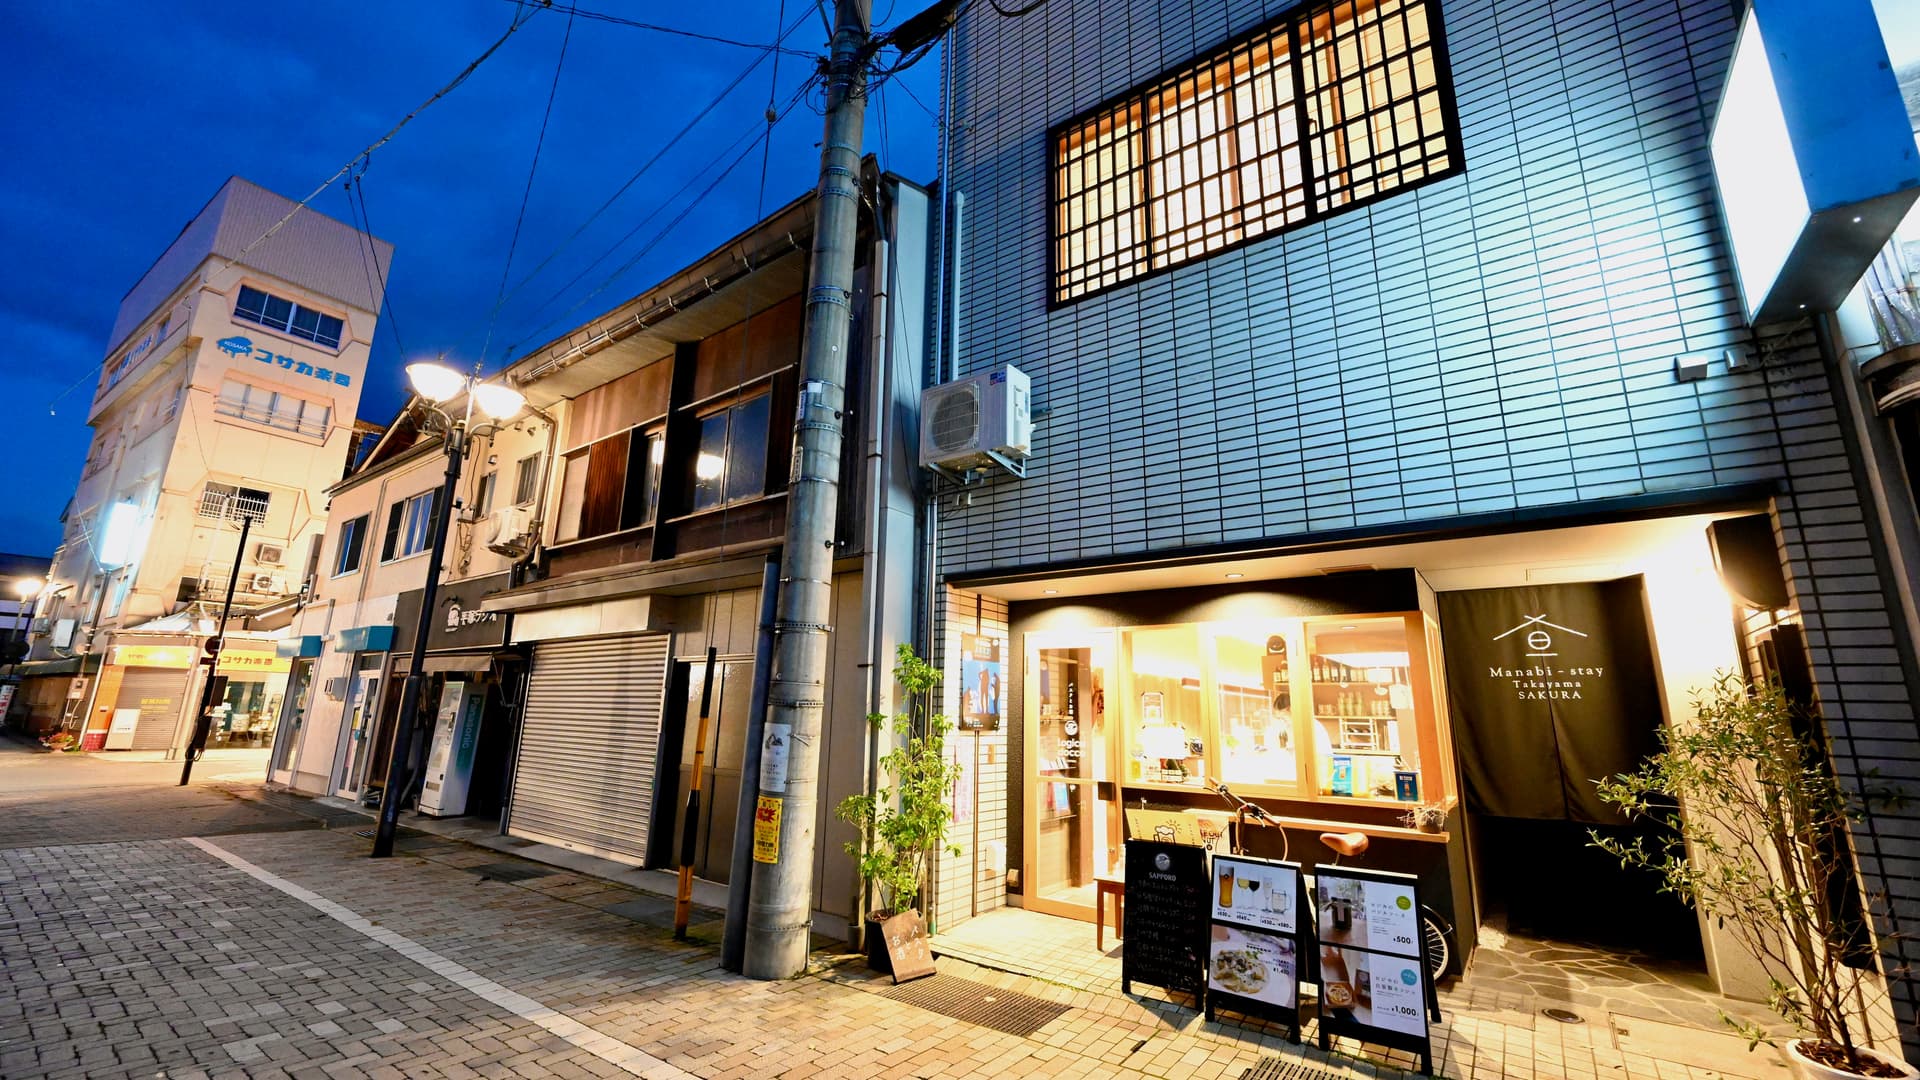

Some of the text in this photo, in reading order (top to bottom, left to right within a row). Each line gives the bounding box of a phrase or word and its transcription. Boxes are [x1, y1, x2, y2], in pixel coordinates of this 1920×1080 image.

[1489, 665, 1552, 678] Manabi
[1570, 666, 1604, 678] stay
[1512, 679, 1582, 689] Takayama
[1518, 690, 1582, 700] SAKURA
[1148, 871, 1177, 882] SAPPORO
